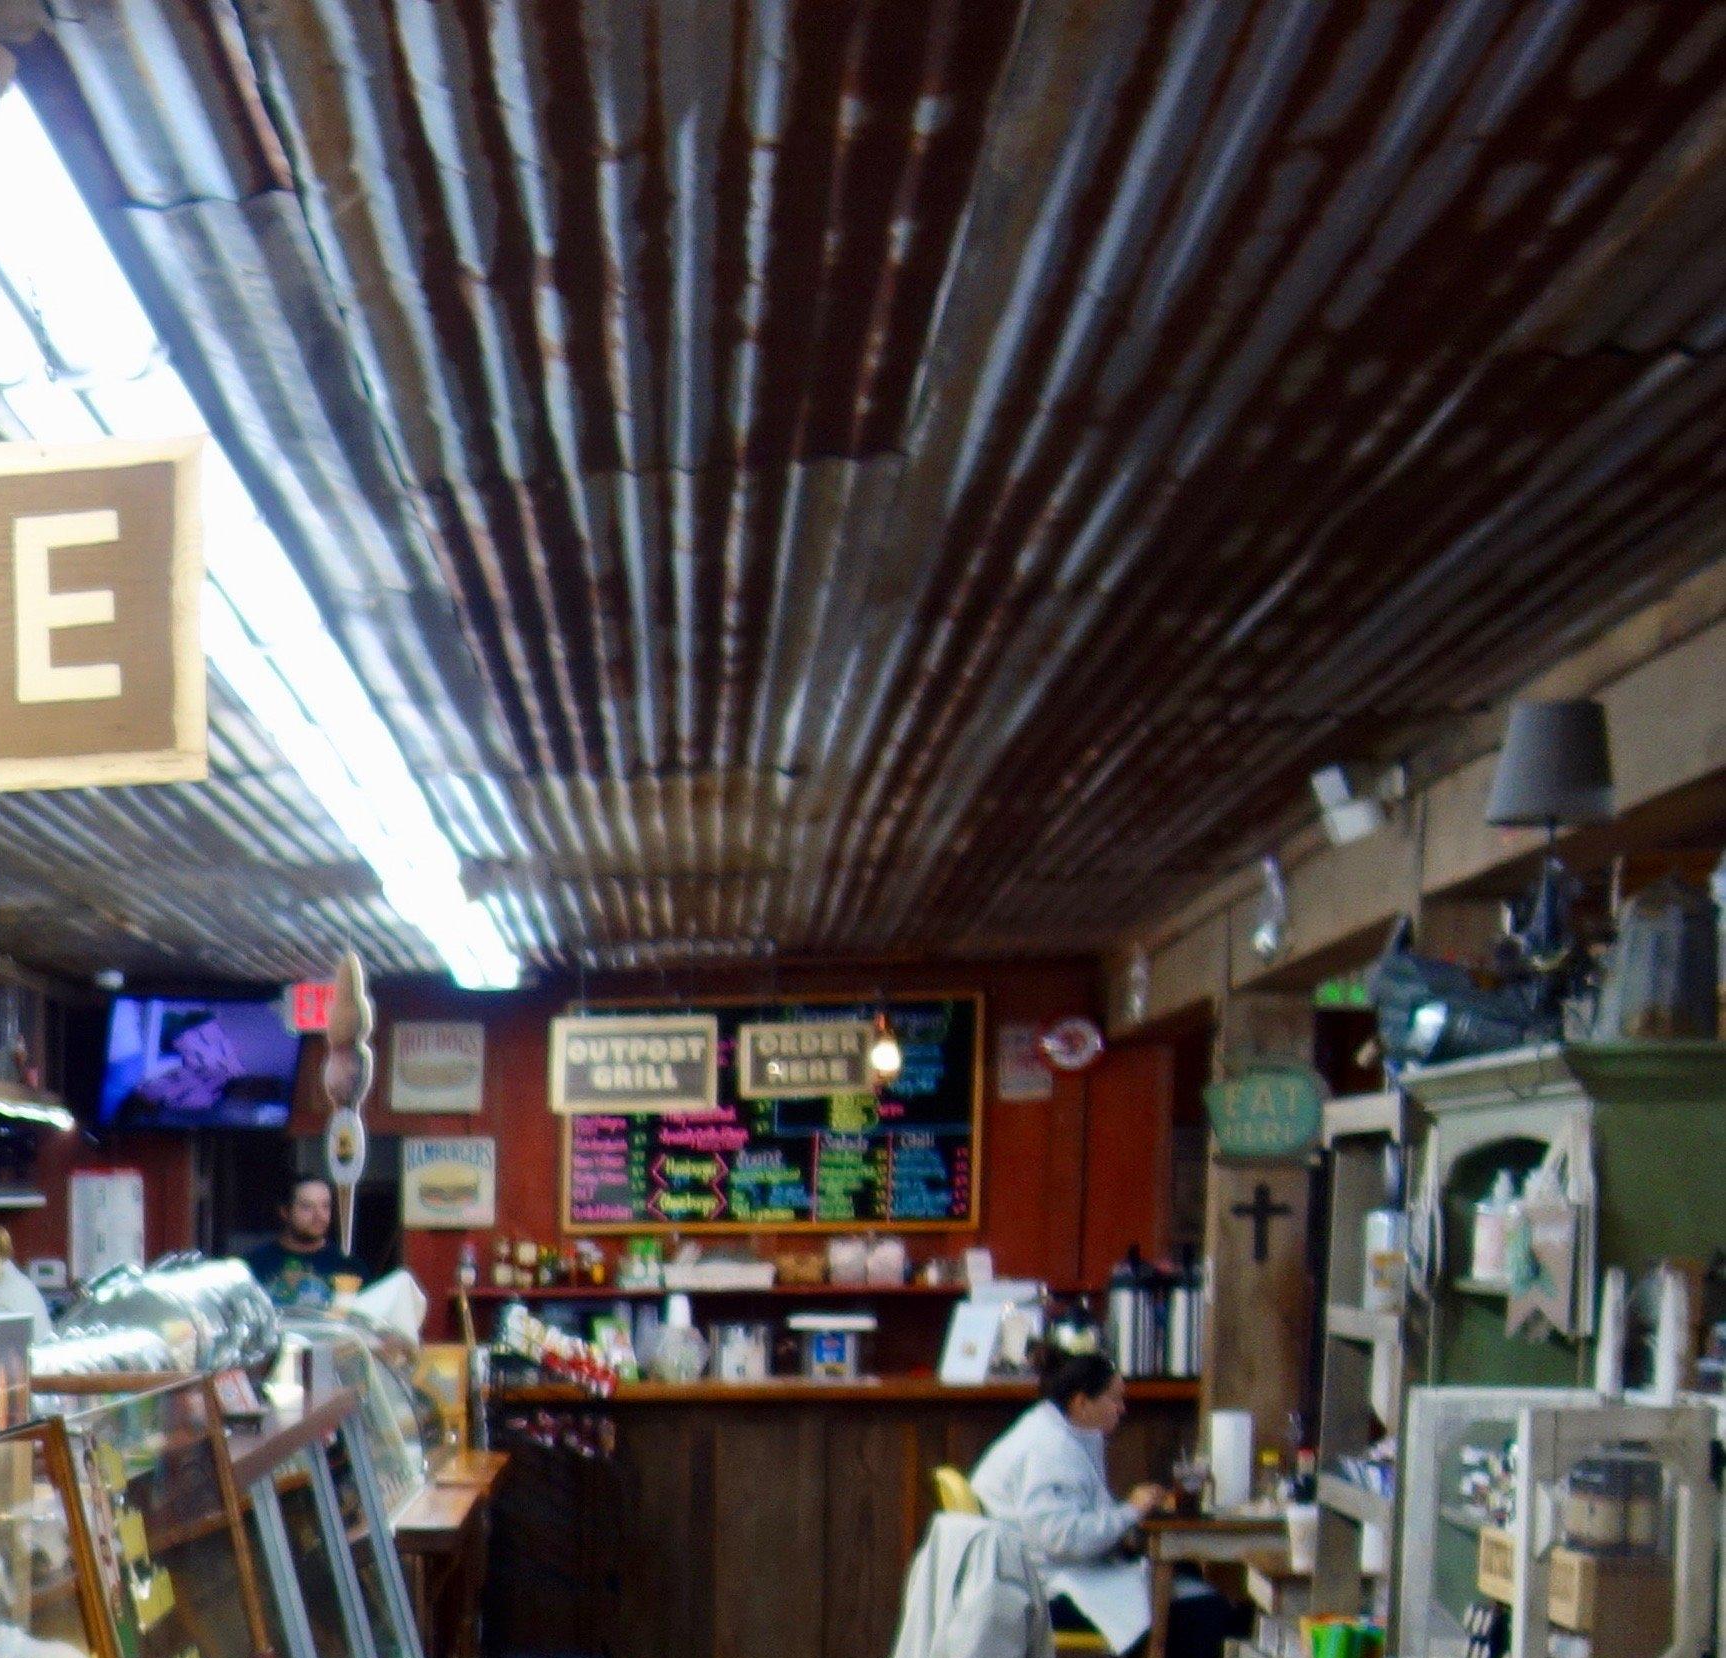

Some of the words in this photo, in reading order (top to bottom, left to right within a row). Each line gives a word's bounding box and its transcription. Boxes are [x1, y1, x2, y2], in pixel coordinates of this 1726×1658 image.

[293, 983, 336, 1030] EX
[566, 1035, 707, 1067] OUTPOST
[756, 1032, 861, 1057] ORDER
[591, 1064, 679, 1091] GRILL
[1222, 1080, 1304, 1118] EAT
